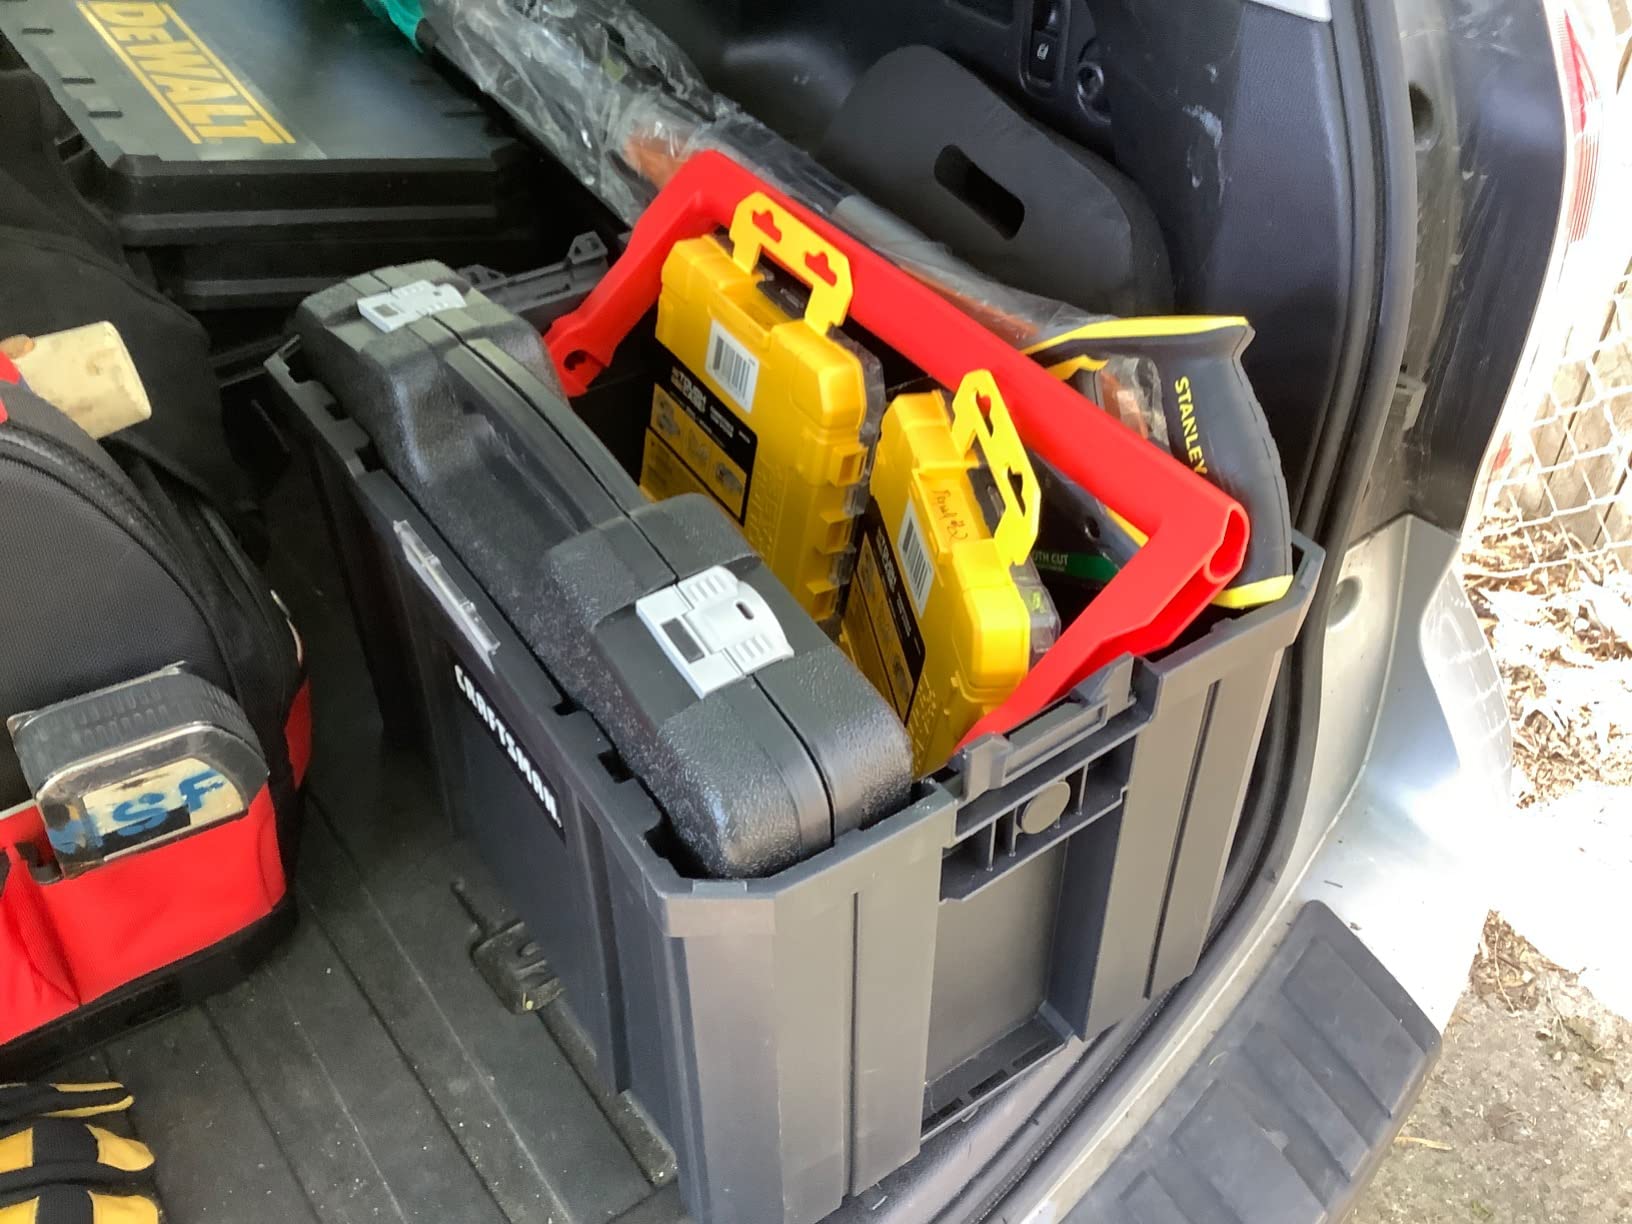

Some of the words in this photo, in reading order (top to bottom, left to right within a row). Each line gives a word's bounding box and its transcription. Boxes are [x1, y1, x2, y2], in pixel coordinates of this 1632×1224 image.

[88, 1, 286, 144] DEWALT
[1174, 376, 1208, 475] STANLEY
[455, 665, 559, 823] CRAFTSMAN
